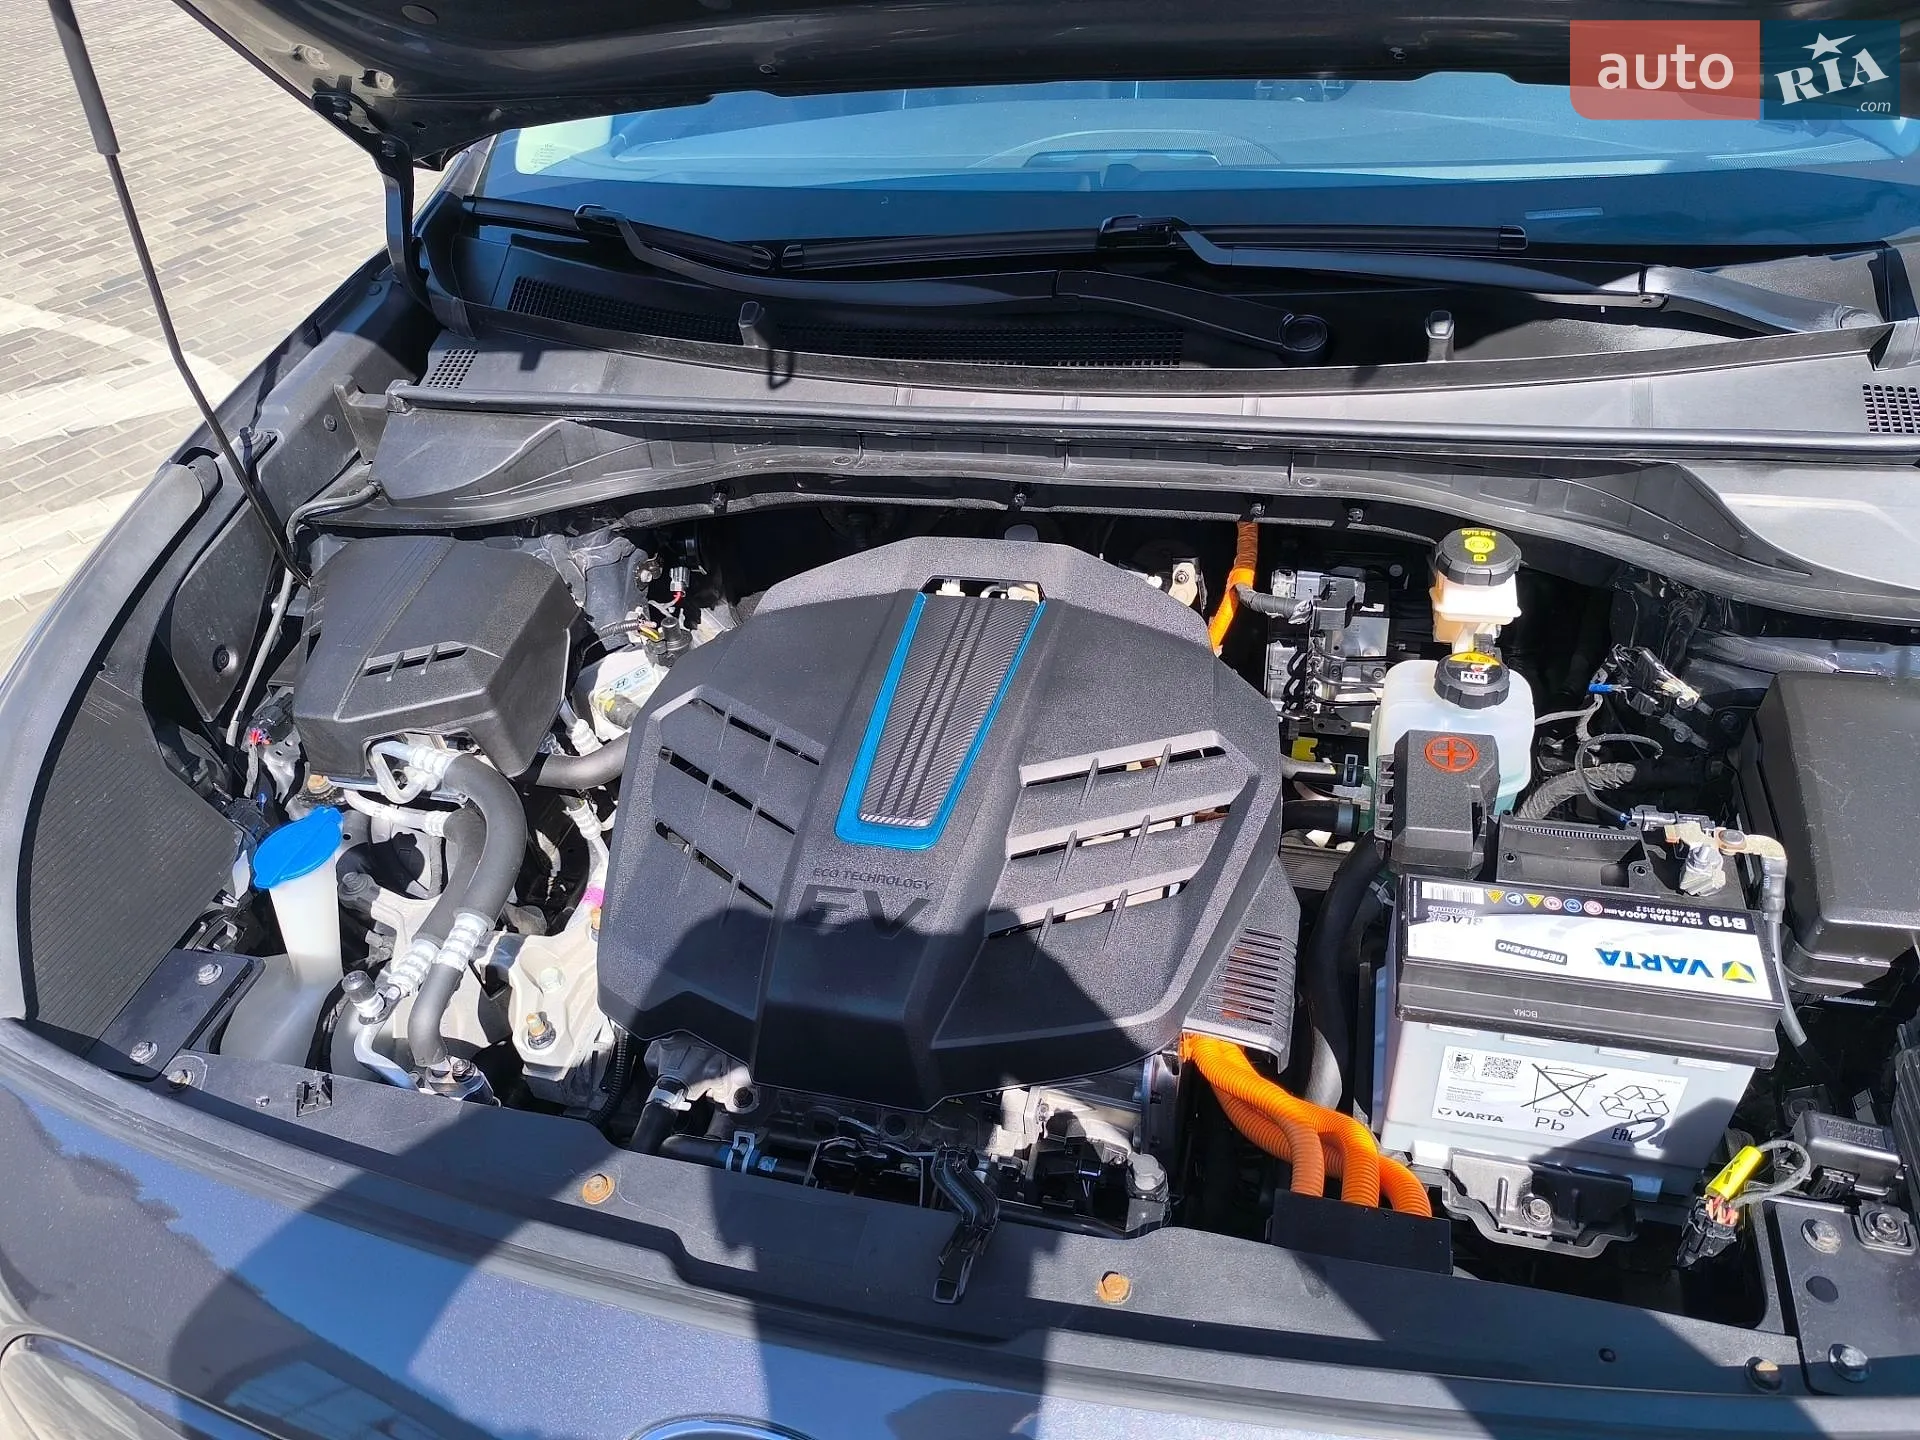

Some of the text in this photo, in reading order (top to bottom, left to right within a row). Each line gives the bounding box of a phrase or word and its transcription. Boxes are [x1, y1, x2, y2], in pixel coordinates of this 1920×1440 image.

[813, 868, 934, 890] ECO TECHNOLOGY
[796, 884, 931, 939] EV
[1682, 917, 1703, 926] 12V
[1708, 914, 1747, 930] B19
[1594, 948, 1714, 978] VARTA
[1455, 1110, 1504, 1123] VARTA
[1534, 1117, 1565, 1131] Pb
